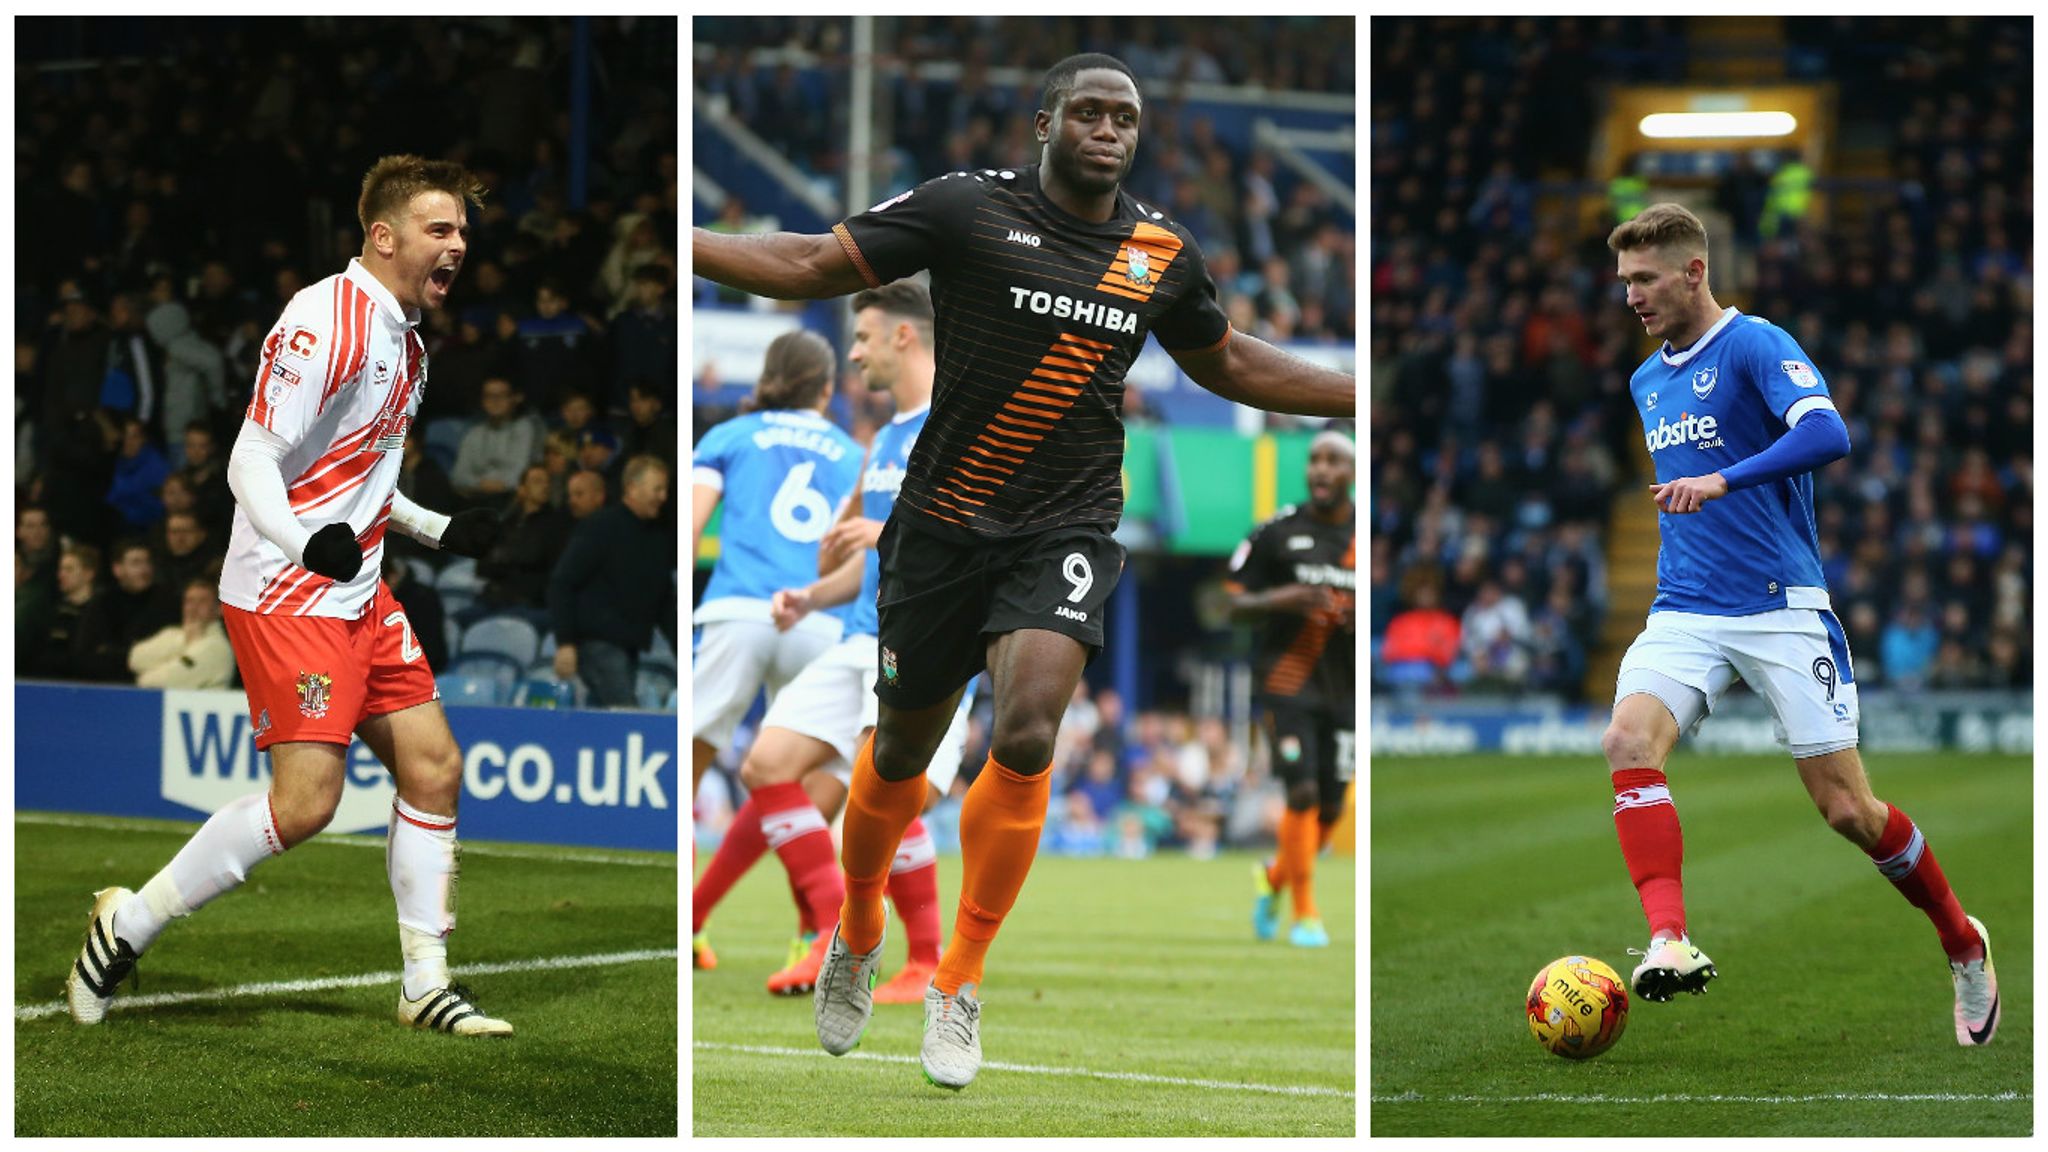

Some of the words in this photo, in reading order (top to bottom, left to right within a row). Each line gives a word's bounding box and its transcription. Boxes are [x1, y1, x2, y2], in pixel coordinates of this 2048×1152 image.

[1007, 230, 1041, 247] JAKO
[1010, 287, 1138, 335] TOSHIBA
[770, 461, 832, 543] 6
[1063, 552, 1093, 603] 9
[1054, 605, 1087, 622] JAKO
[1813, 656, 1836, 701] 9
[1552, 978, 1593, 1016] mitre
